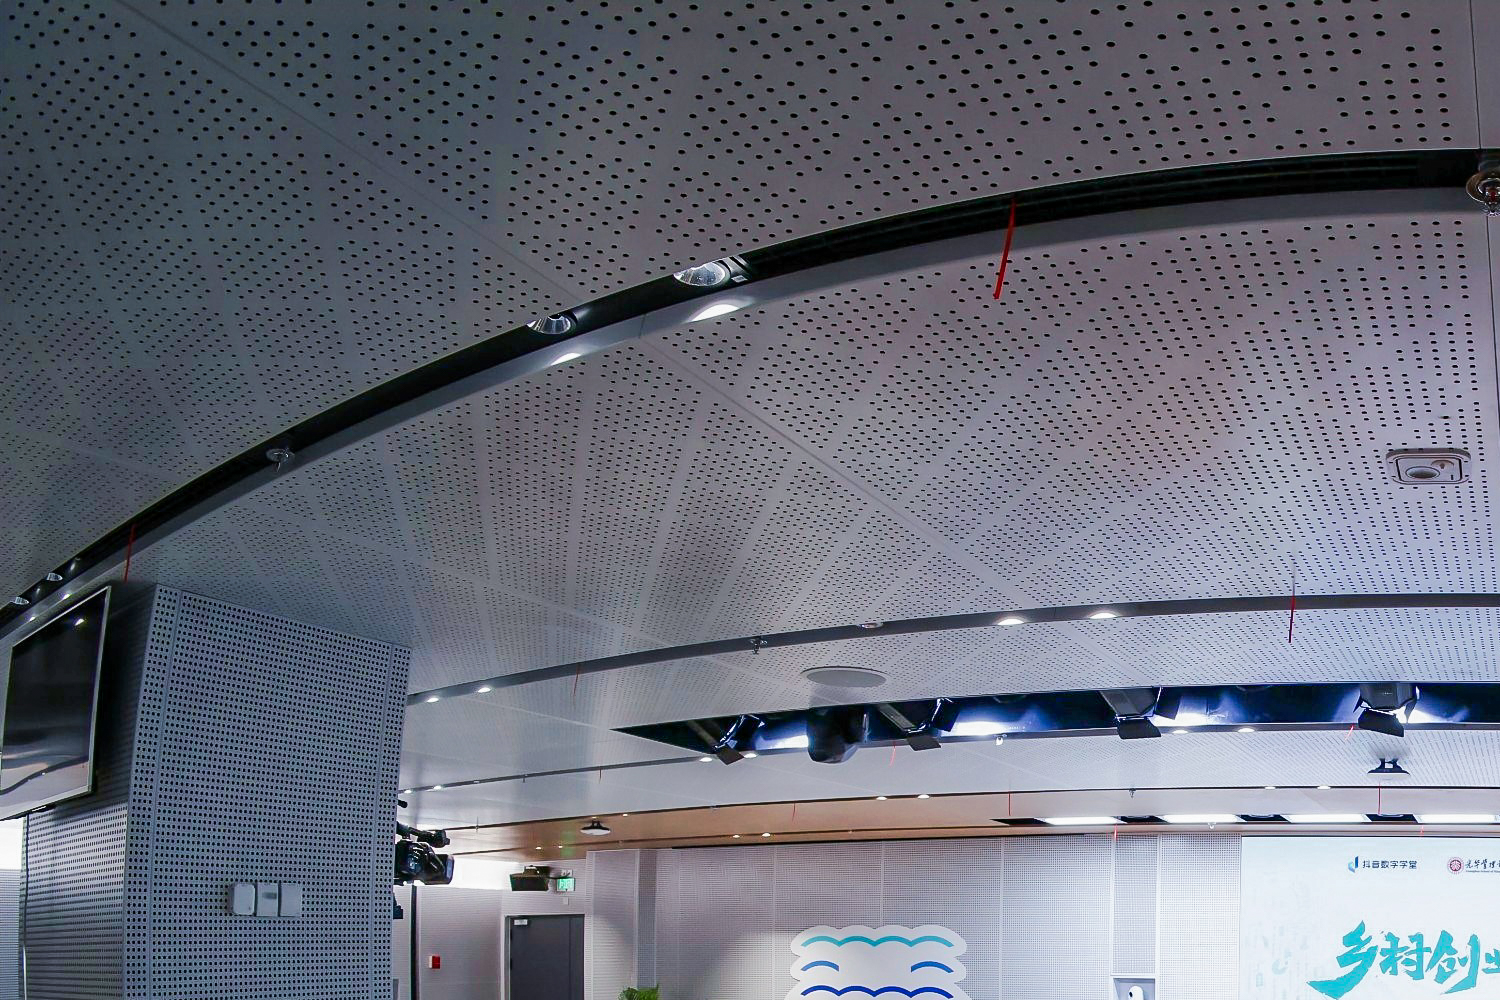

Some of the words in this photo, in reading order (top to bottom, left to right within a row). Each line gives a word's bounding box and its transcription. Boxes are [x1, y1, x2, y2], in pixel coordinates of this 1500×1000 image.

[1362, 859, 1418, 870] 抖音数字学堂
